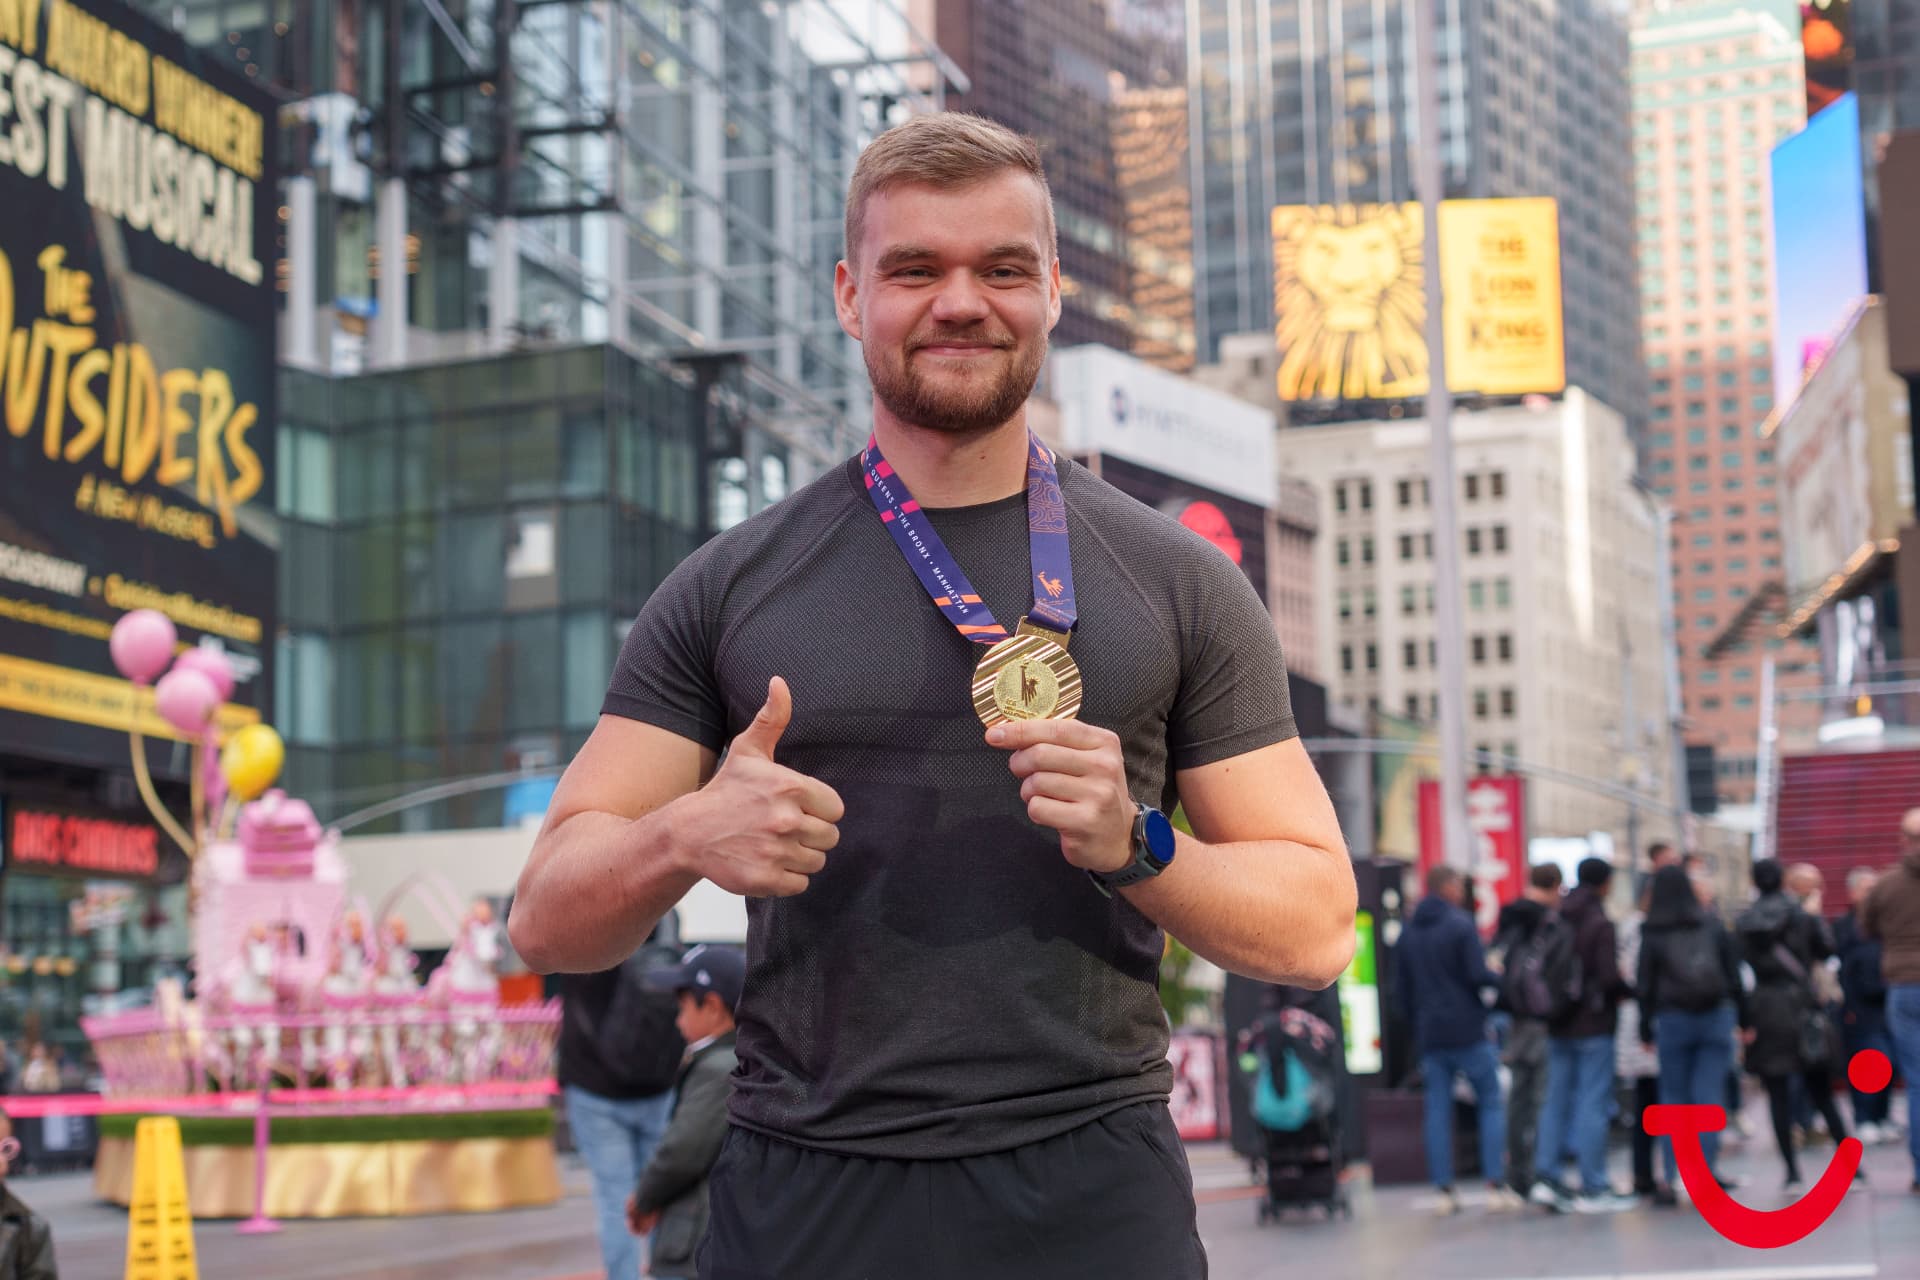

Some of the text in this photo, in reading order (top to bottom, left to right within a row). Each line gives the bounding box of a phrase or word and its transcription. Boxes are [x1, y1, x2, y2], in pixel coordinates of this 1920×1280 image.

[46, 0, 149, 117] AWARD
[152, 54, 264, 182] WINNER!
[84, 93, 263, 286] MUSICAL
[871, 469, 969, 614] QUEENS THE BRONX MANHATTAN
